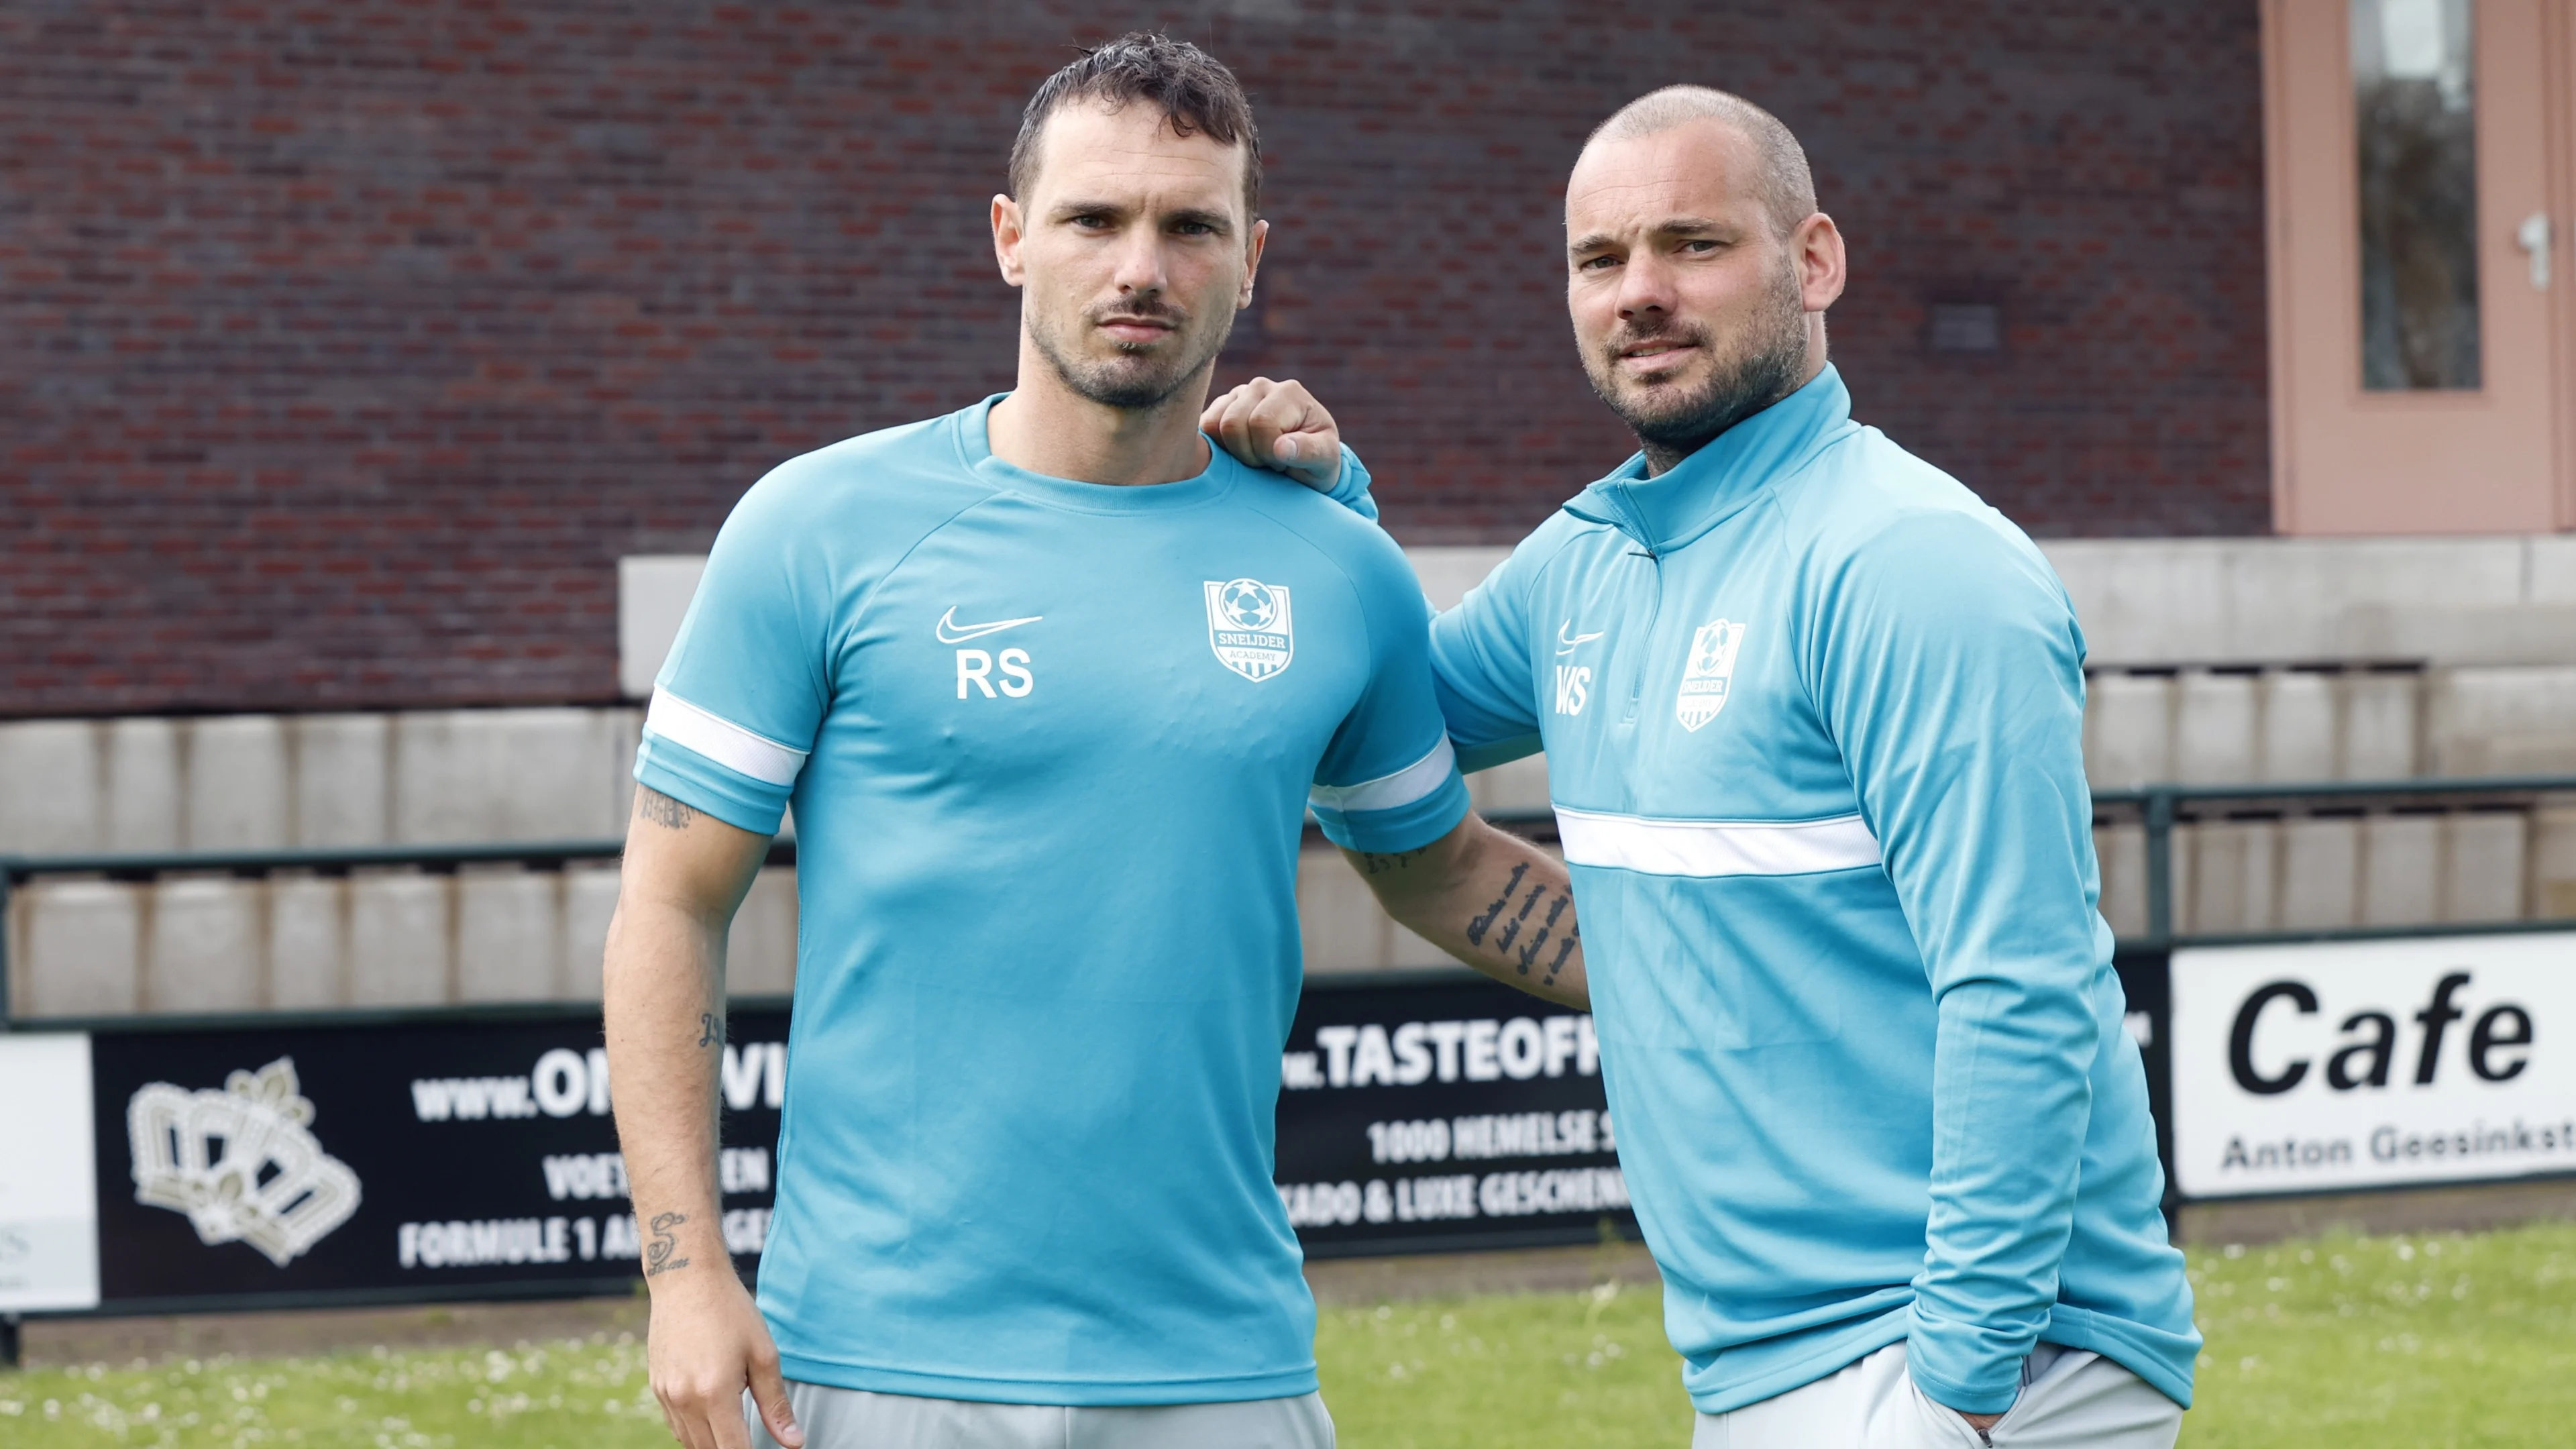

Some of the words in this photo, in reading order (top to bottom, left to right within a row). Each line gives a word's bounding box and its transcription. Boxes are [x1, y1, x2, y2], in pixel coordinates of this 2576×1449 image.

[1218, 633, 1286, 649] SNEIJDER
[1230, 650, 1276, 661] ACADEMY
[956, 648, 1034, 699] RS
[1555, 665, 1591, 716] WS
[2227, 972, 2533, 1096] Cafe
[1367, 1118, 1450, 1164] 1000
[1452, 1109, 1598, 1160] HEMELSE
[2220, 1136, 2353, 1171] Anton
[2369, 1120, 2576, 1164] Geesinkst
[1362, 1179, 1395, 1224] &
[1395, 1174, 1478, 1222] LUXE
[1479, 1166, 1633, 1217] GESCHEN
[398, 1216, 570, 1268] FORMULE
[573, 1217, 597, 1259] 1
